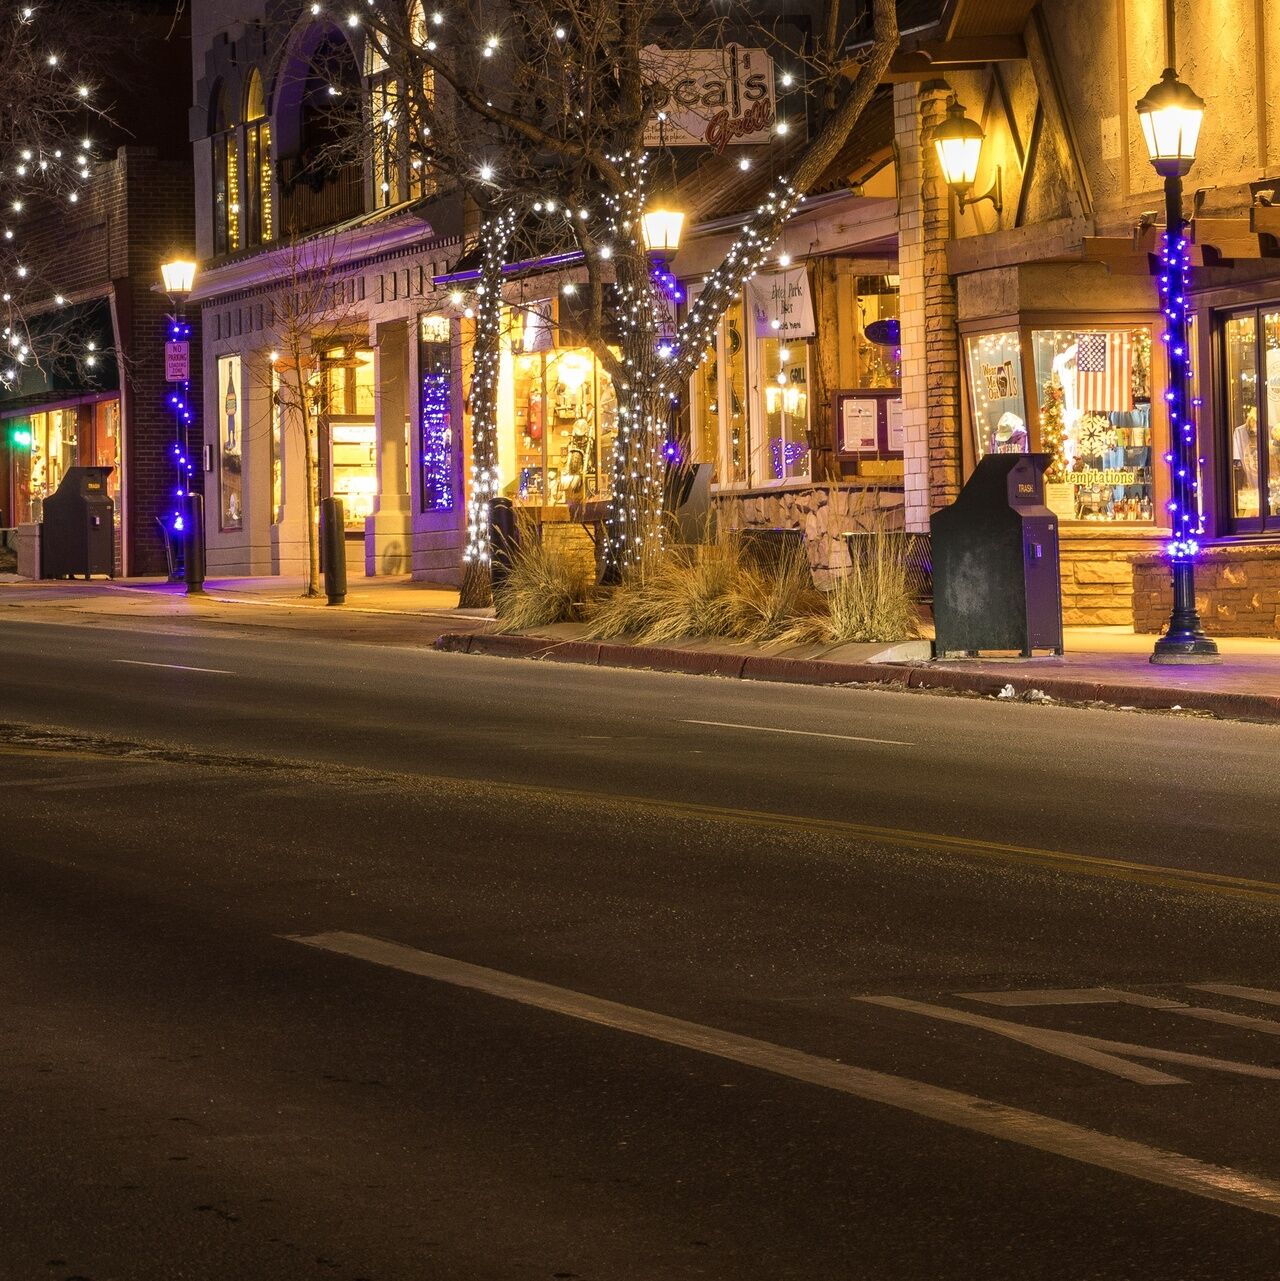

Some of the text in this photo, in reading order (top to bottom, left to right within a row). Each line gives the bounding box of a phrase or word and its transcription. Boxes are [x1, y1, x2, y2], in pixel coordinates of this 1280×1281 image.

[705, 98, 775, 155] Grill
[173, 345, 182, 353] NO
[168, 353, 187, 361] PARKING
[1065, 469, 1134, 487] temptations
[1018, 484, 1035, 493] TRASH
